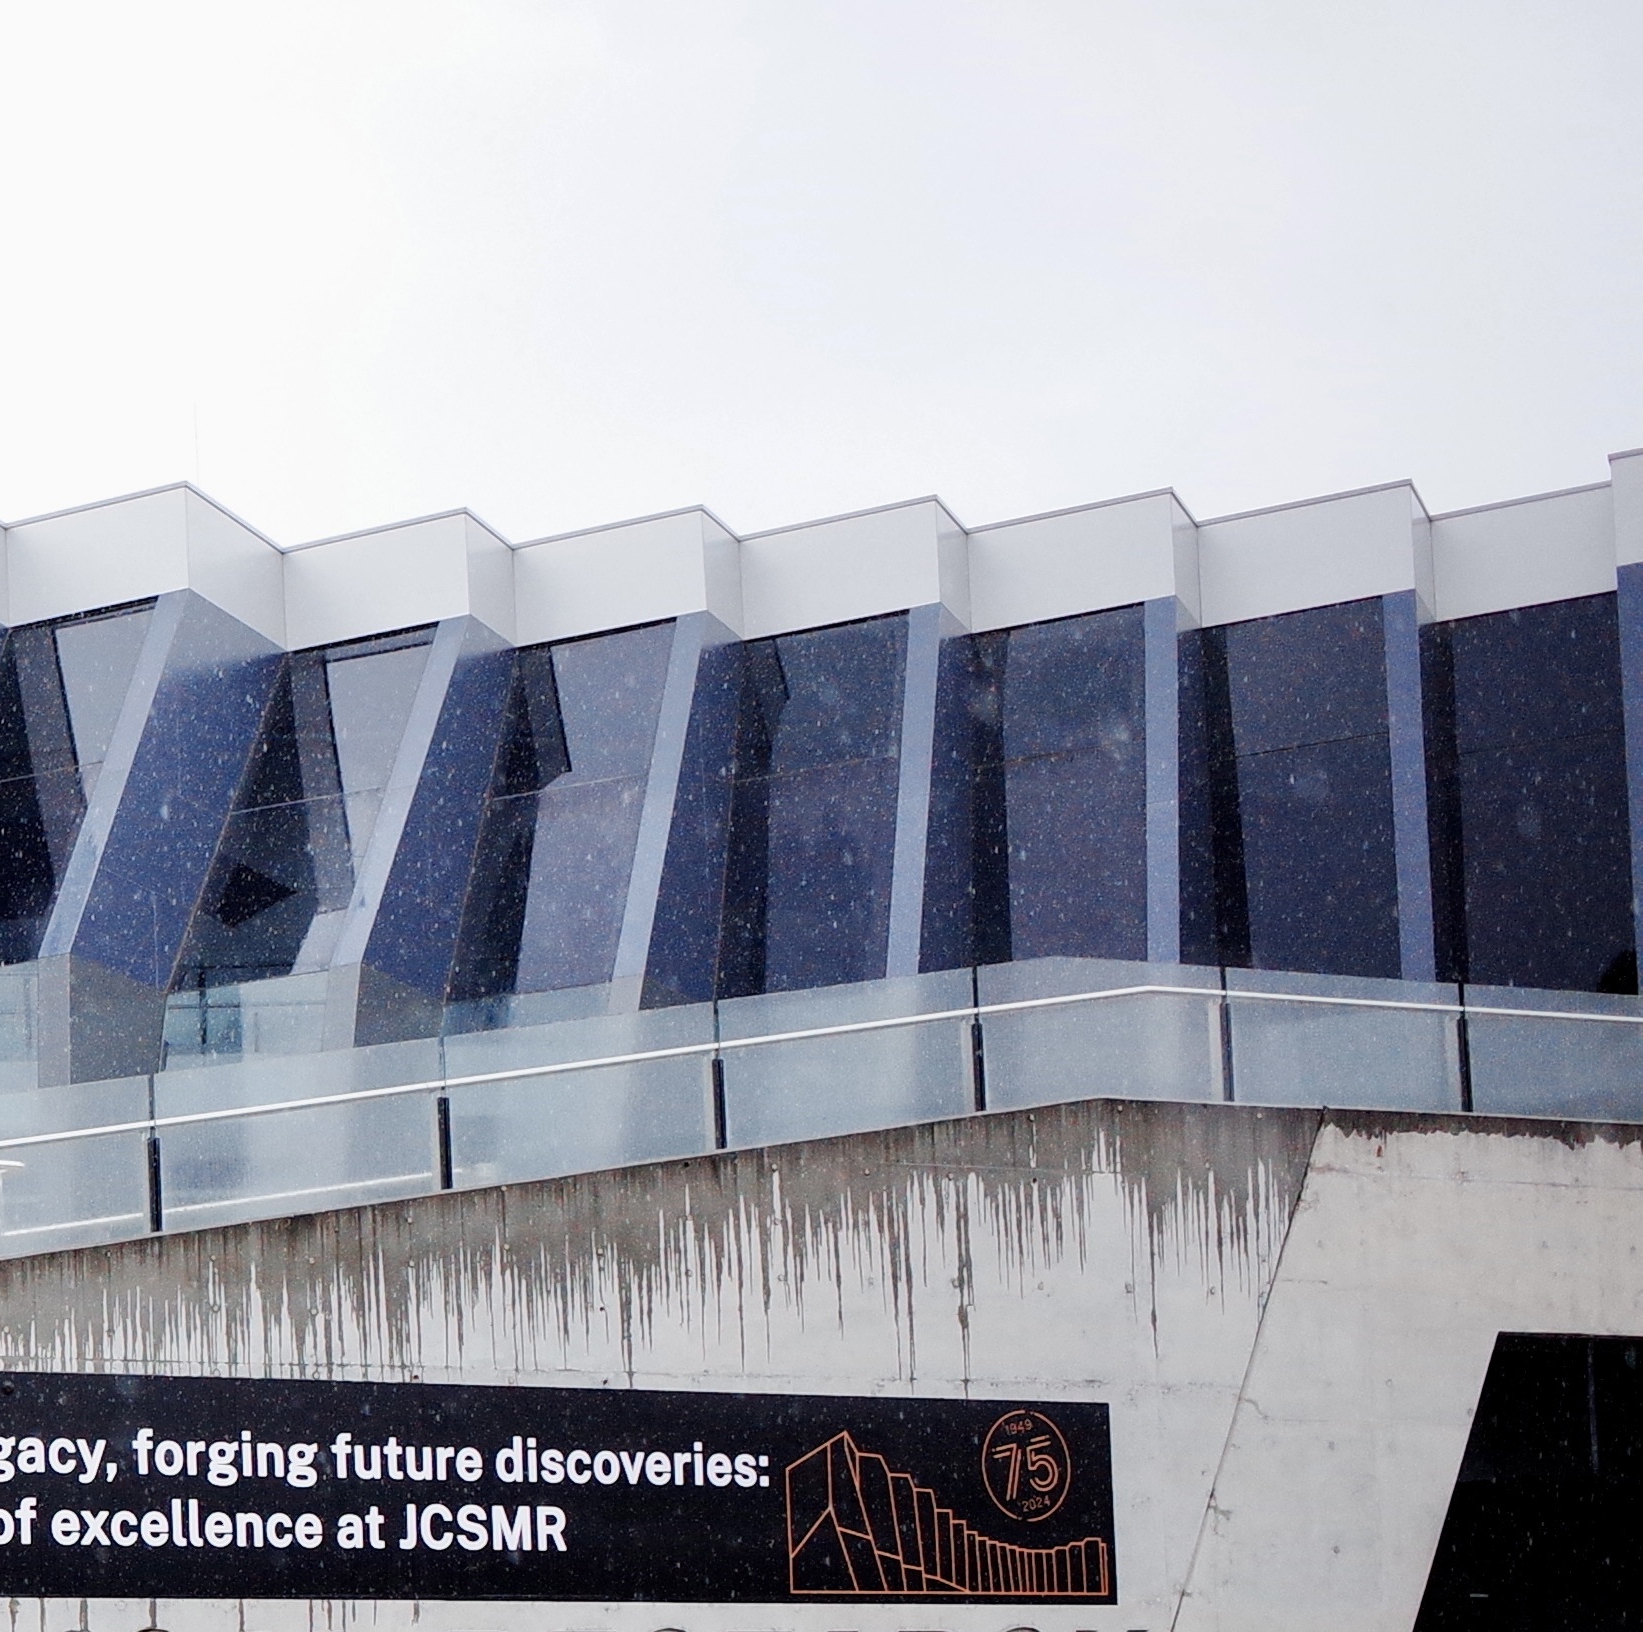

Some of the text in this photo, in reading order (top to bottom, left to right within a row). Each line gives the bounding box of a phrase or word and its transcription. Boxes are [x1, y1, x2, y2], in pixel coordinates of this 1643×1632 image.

[1005, 1418, 1033, 1436] 1949
[131, 1427, 318, 1488] forging
[329, 1432, 483, 1481] future
[495, 1435, 770, 1488] discoveries:
[991, 1434, 1059, 1501] 75
[51, 1498, 323, 1549] excellence
[336, 1505, 386, 1550] at
[399, 1503, 568, 1552] JCSMR
[1021, 1494, 1051, 1512] 2024
